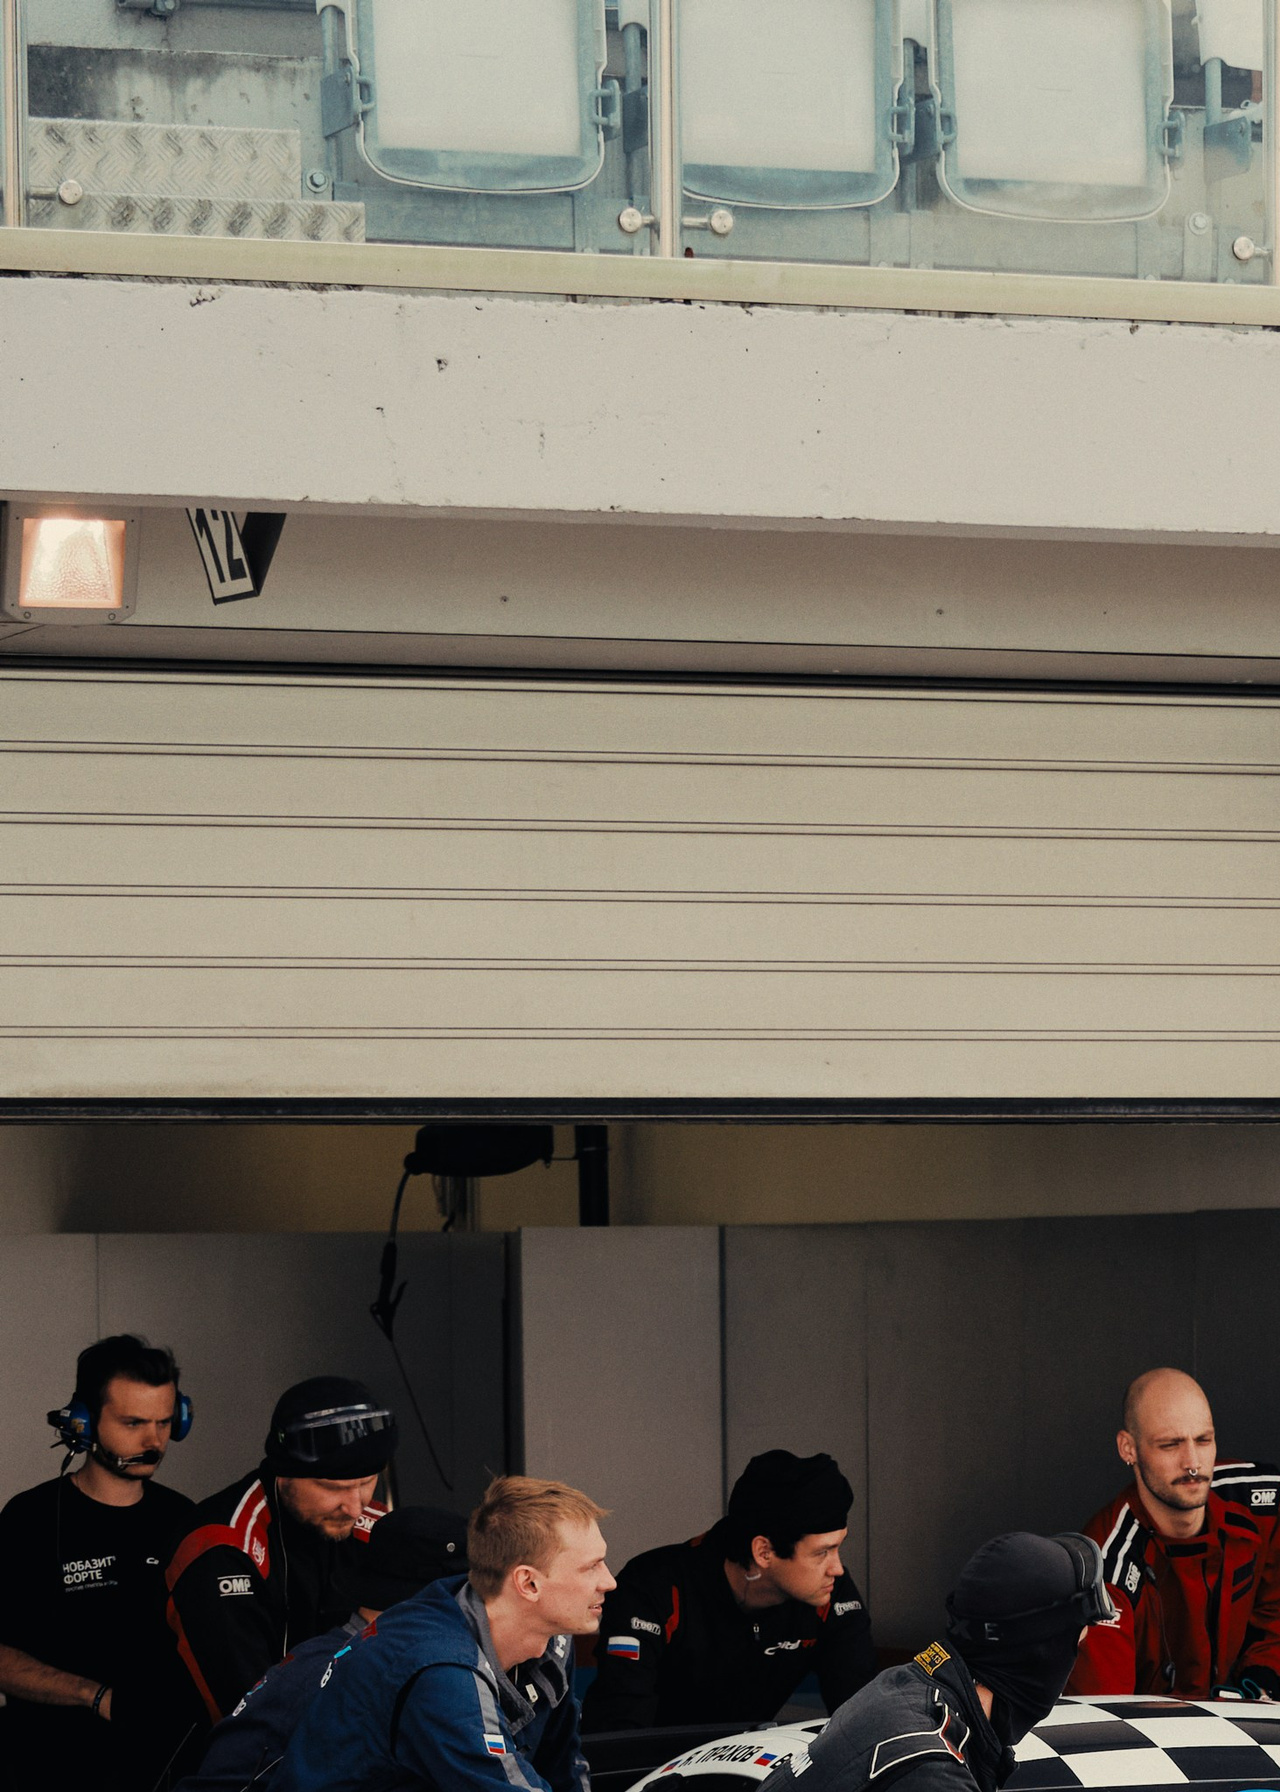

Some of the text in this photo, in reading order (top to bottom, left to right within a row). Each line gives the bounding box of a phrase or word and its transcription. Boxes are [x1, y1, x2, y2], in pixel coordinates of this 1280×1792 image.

[195, 508, 247, 584] 12
[1251, 1491, 1276, 1504] OMP
[63, 1569, 102, 1584] ФОРТЕ
[219, 1578, 251, 1593] OMP
